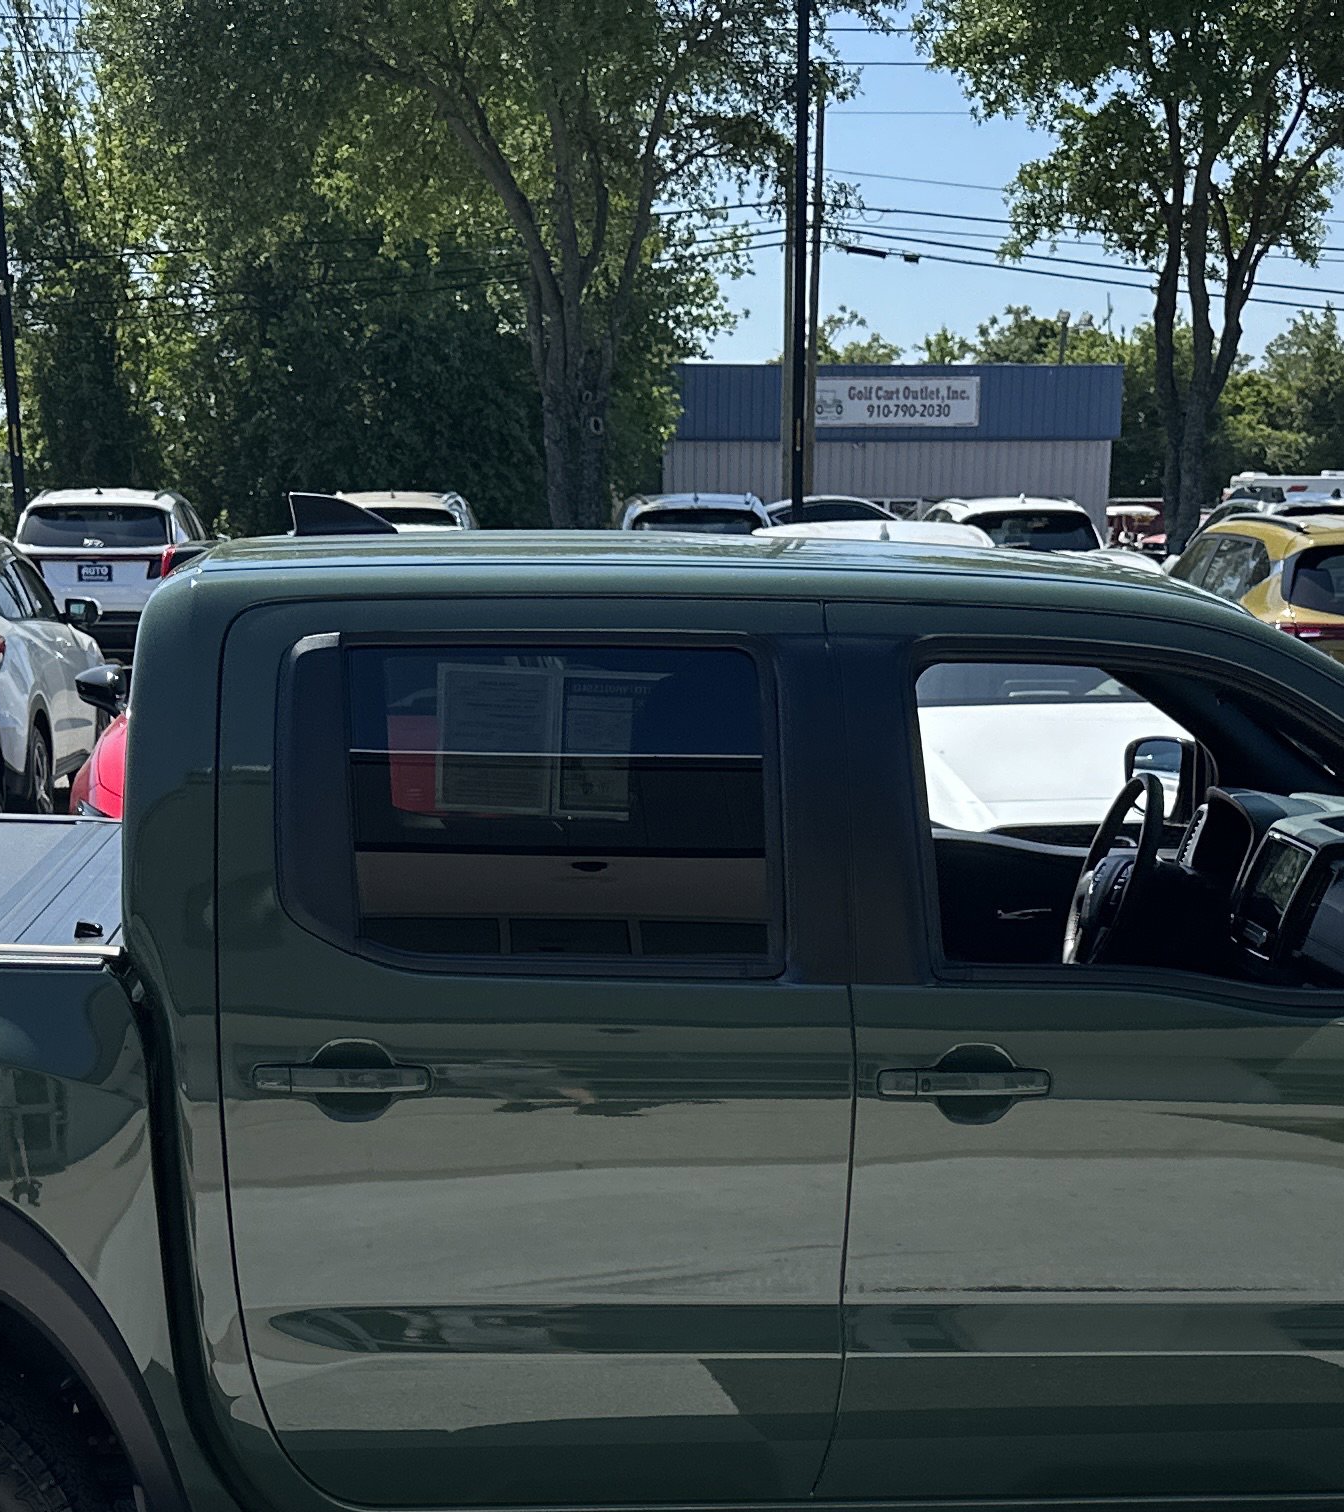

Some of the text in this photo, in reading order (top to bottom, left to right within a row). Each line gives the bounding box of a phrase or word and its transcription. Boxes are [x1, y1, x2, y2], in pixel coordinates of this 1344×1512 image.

[848, 386, 970, 403] Golf Cart Outlet, Inc.
[867, 404, 951, 418] 910-790-2030
[81, 566, 109, 575] AUTO
